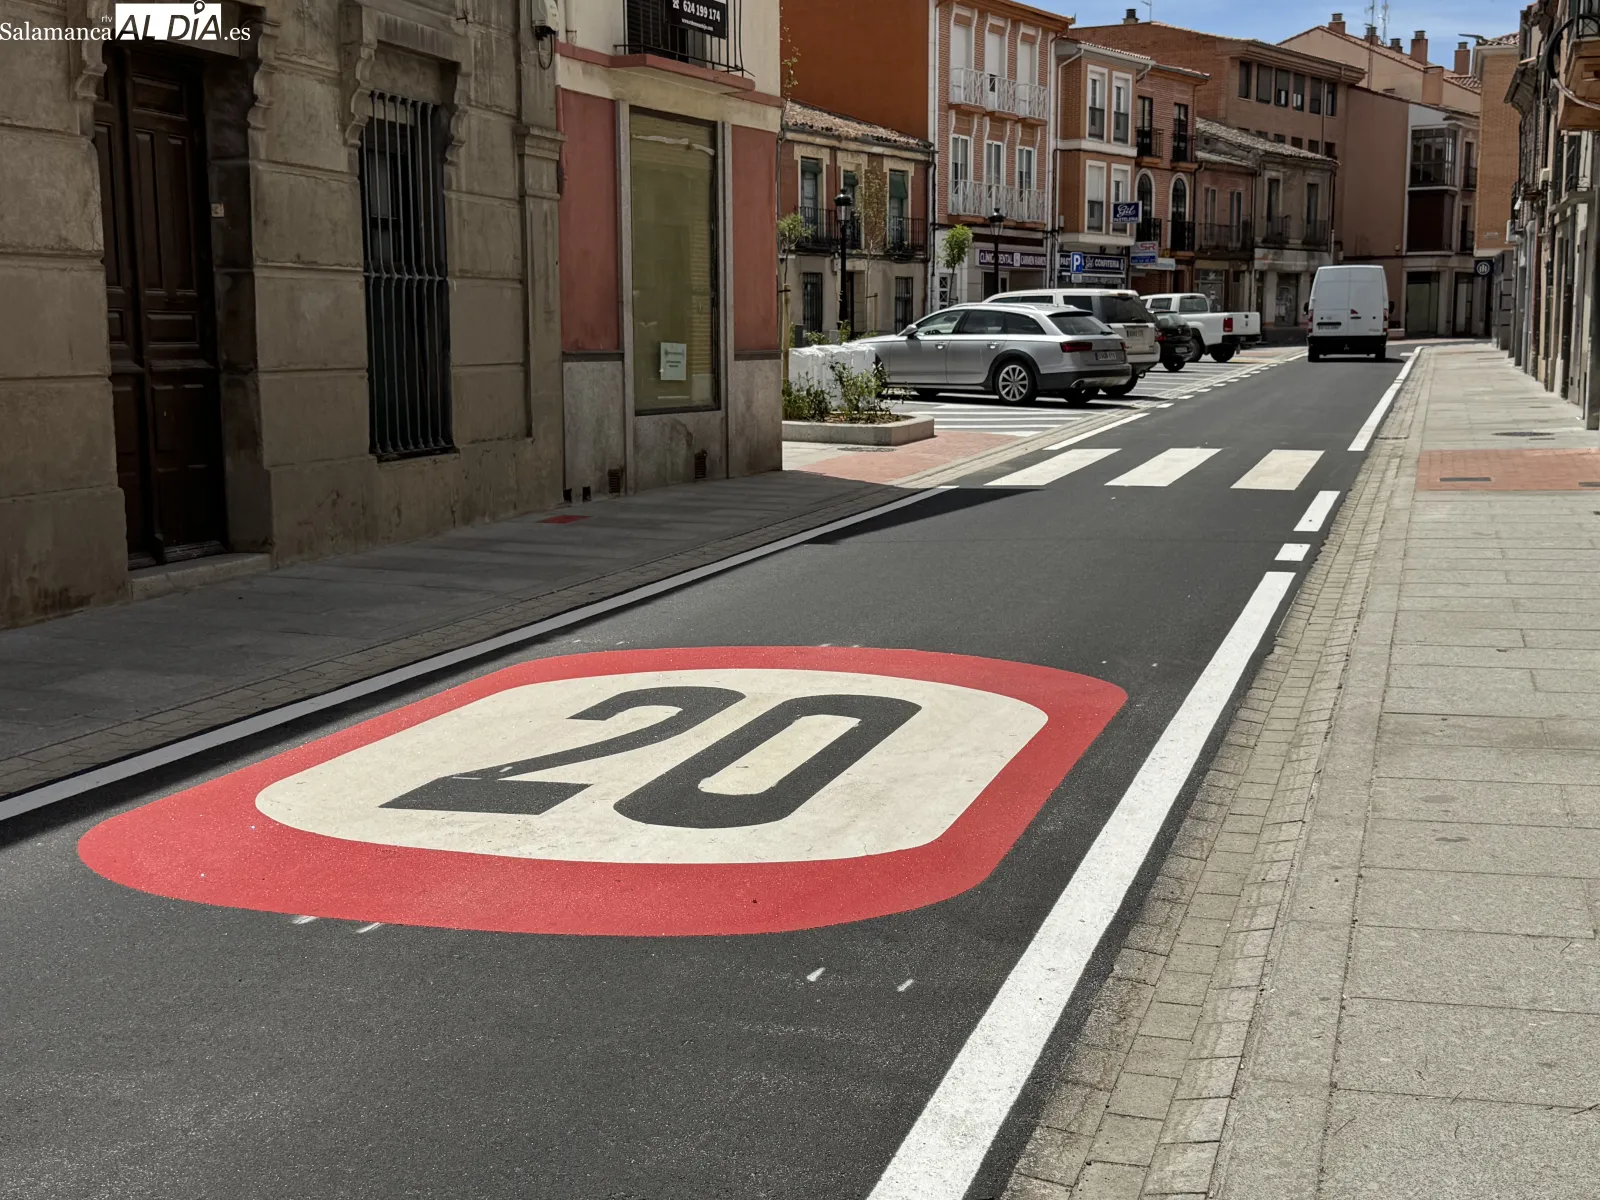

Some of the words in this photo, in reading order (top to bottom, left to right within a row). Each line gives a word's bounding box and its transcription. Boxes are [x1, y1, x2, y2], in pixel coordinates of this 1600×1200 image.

[682, 0, 695, 15] 624
[696, 4, 708, 18] 199
[708, 8, 721, 22] 174
[1073, 254, 1081, 271] P
[378, 686, 923, 829] 20
